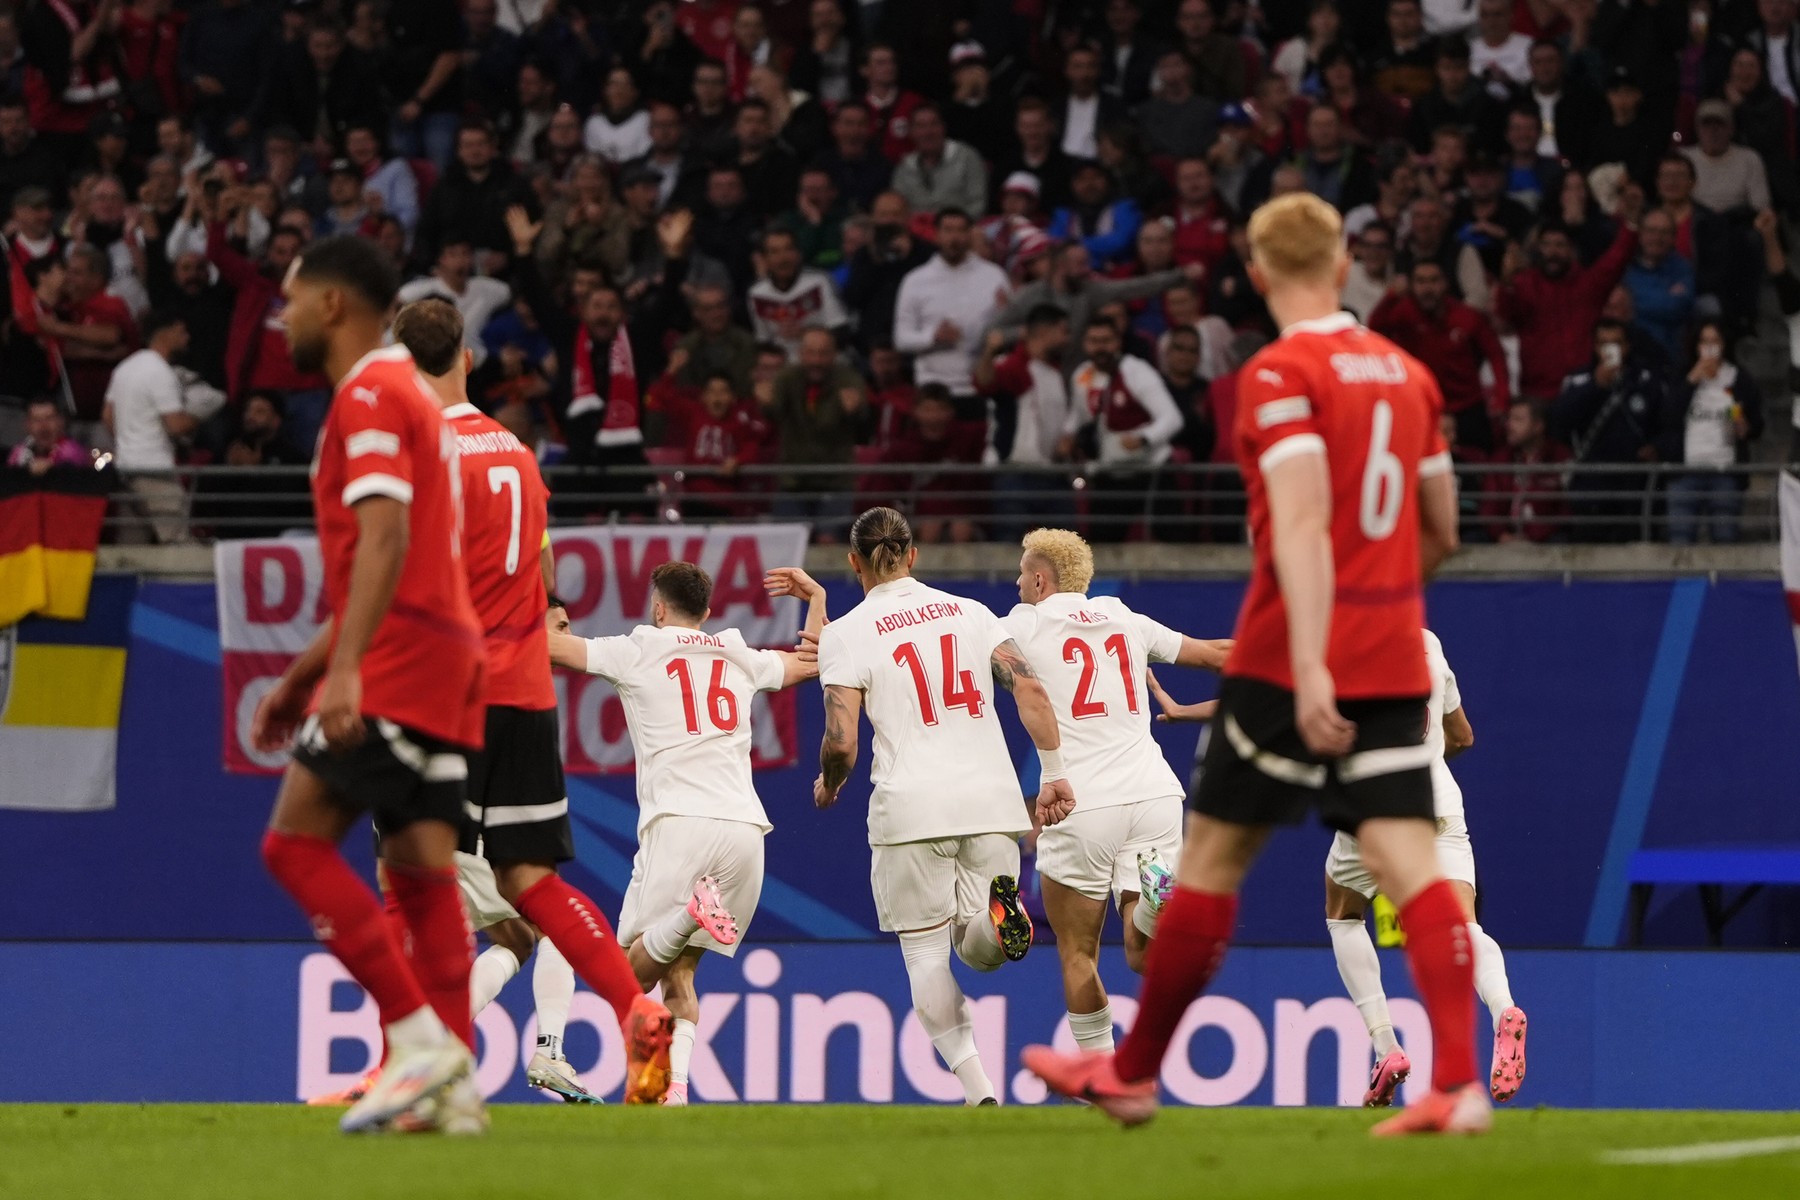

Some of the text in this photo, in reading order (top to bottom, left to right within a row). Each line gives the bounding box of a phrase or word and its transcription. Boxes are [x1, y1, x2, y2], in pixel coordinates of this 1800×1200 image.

[1360, 399, 1405, 541] 6
[487, 466, 522, 576] 7
[666, 658, 740, 736] 16
[892, 633, 985, 727] 14
[1062, 633, 1140, 721] 21
